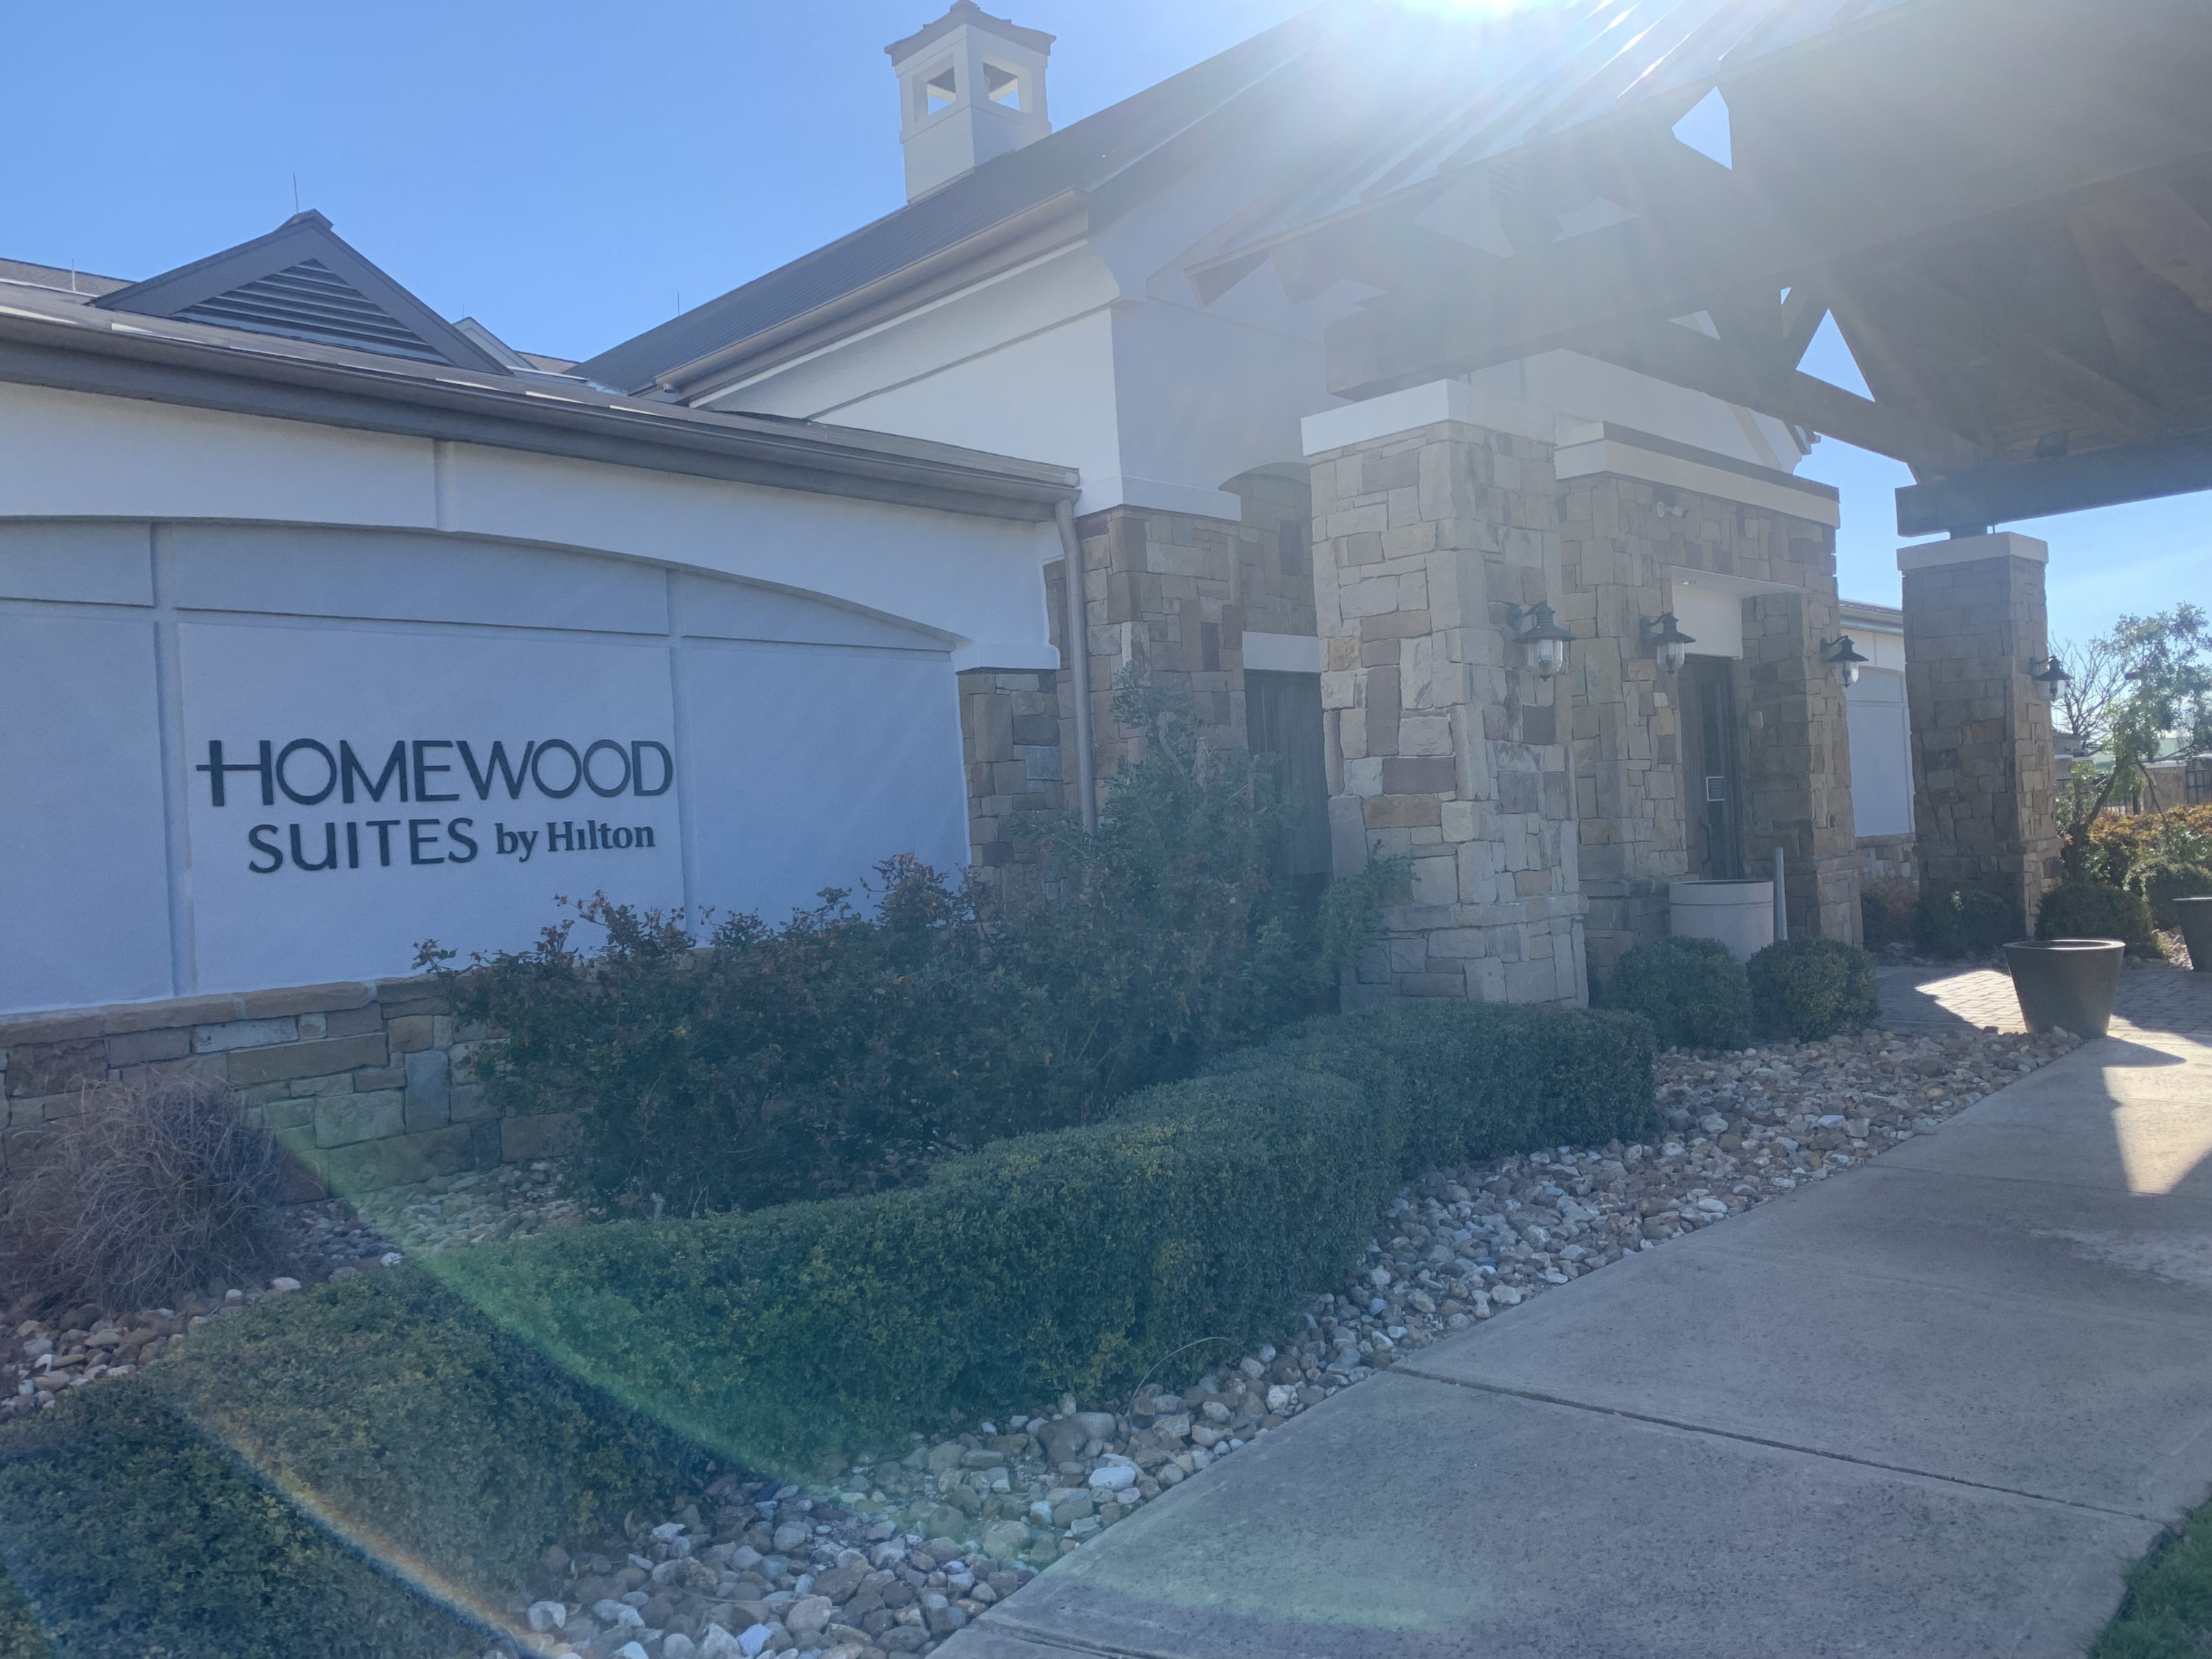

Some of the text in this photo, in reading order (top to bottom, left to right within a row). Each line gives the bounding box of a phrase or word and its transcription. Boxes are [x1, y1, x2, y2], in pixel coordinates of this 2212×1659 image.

[196, 738, 673, 807] HOMEWOOD
[248, 818, 656, 874] SUITES by Hilton
